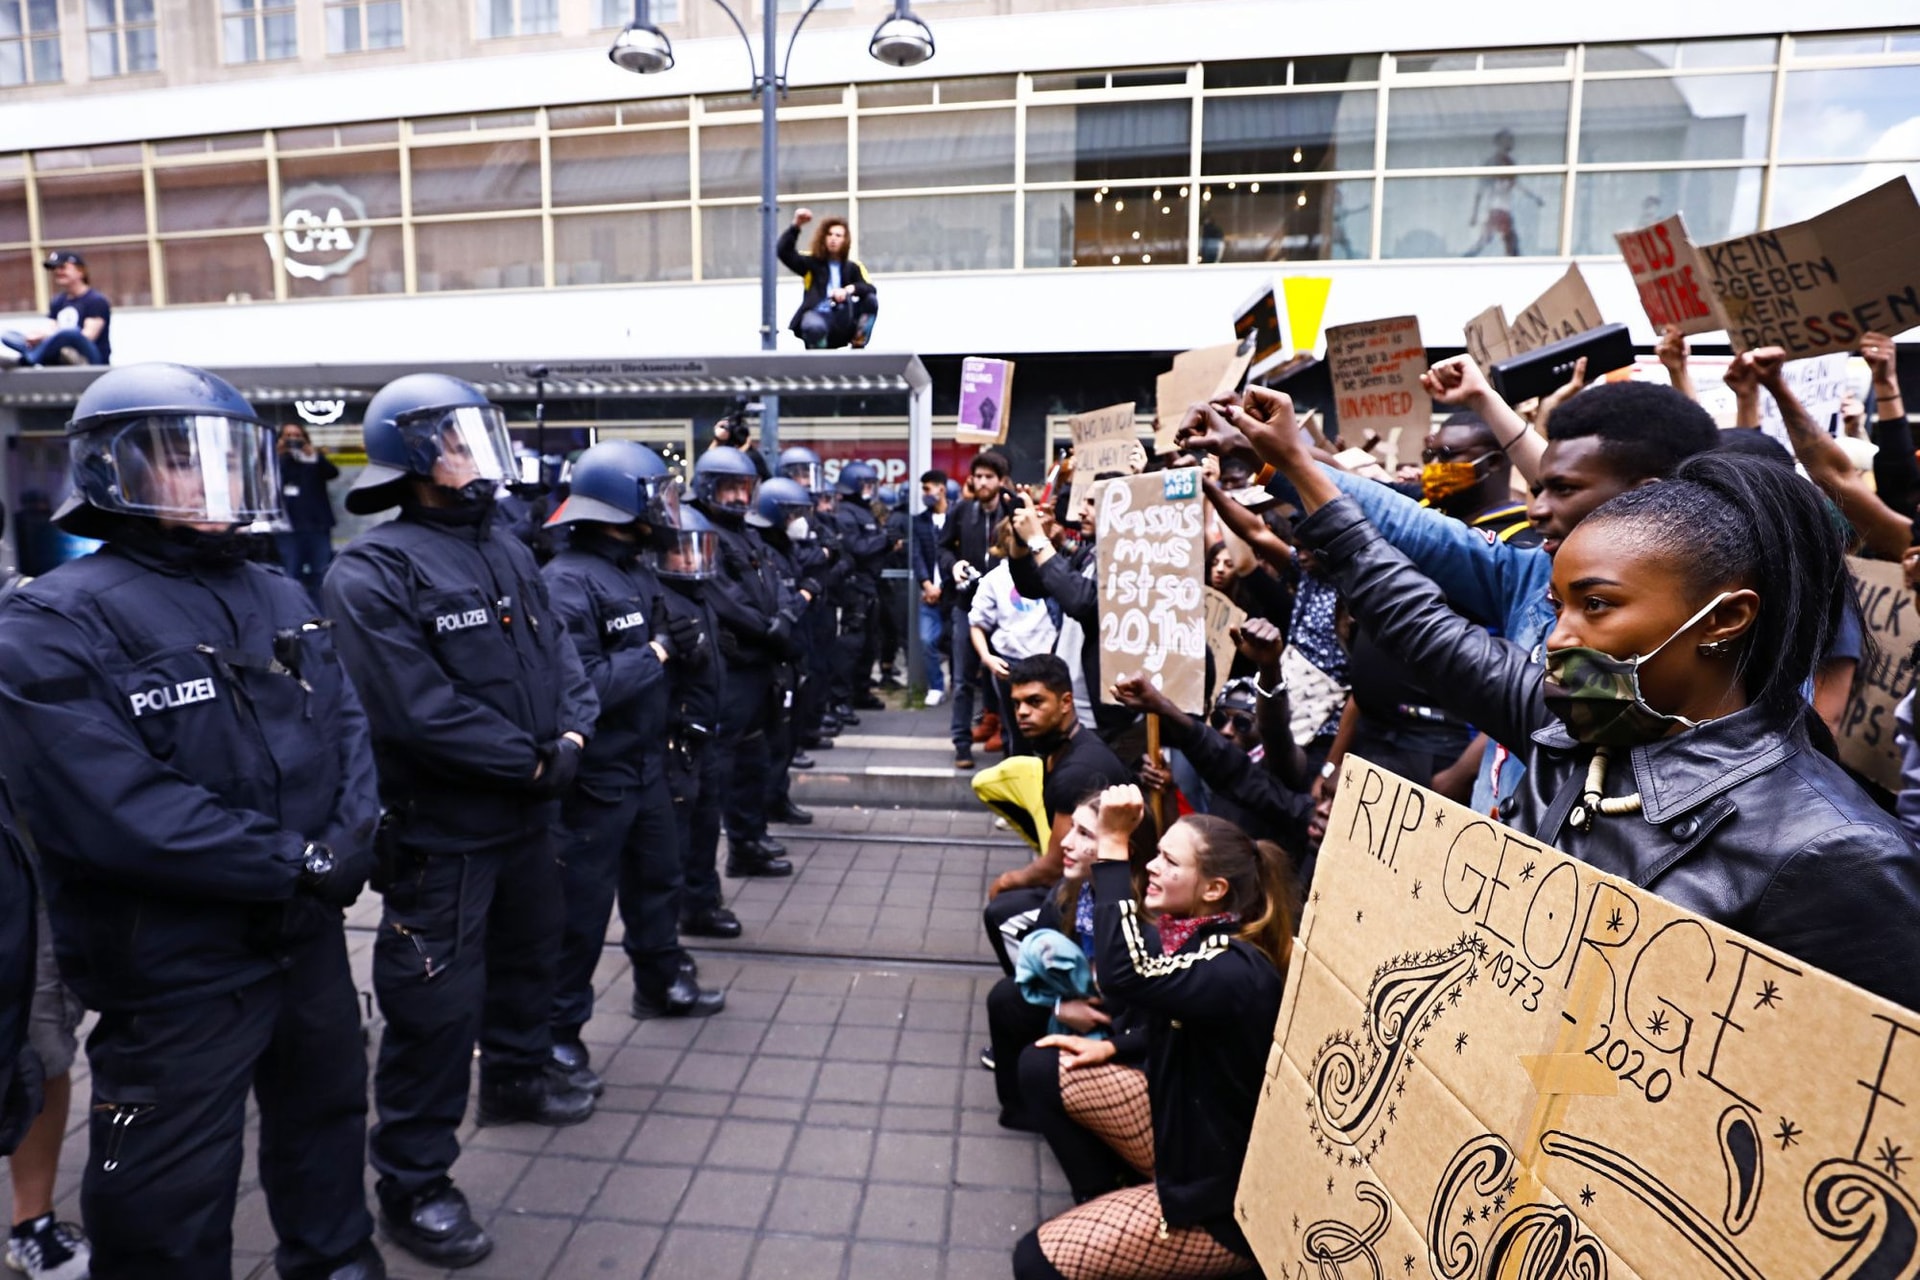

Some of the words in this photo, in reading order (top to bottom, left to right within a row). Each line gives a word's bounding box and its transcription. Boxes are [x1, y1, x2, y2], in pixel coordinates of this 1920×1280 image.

[283, 207, 354, 252] C&A
[1706, 230, 1788, 280] KEIN
[1740, 295, 1799, 326] KEIN
[1337, 355, 1363, 369] seen
[1347, 341, 1365, 353] your
[1360, 376, 1386, 389] seen
[1339, 391, 1413, 419] UNARMED
[824, 458, 906, 484] SOP
[1166, 482, 1192, 496] AFD
[1100, 480, 1202, 538] Rassis
[1113, 537, 1191, 567] mus
[1106, 563, 1154, 606] ist
[1156, 575, 1201, 610] so
[436, 608, 488, 632] POLIZEI
[1850, 576, 1910, 637] UCK
[130, 678, 216, 716] POLIZEI
[1443, 821, 1802, 1113] GEORGE
[1485, 951, 1544, 1012] 1973
[1584, 1024, 1672, 1103] 2020
